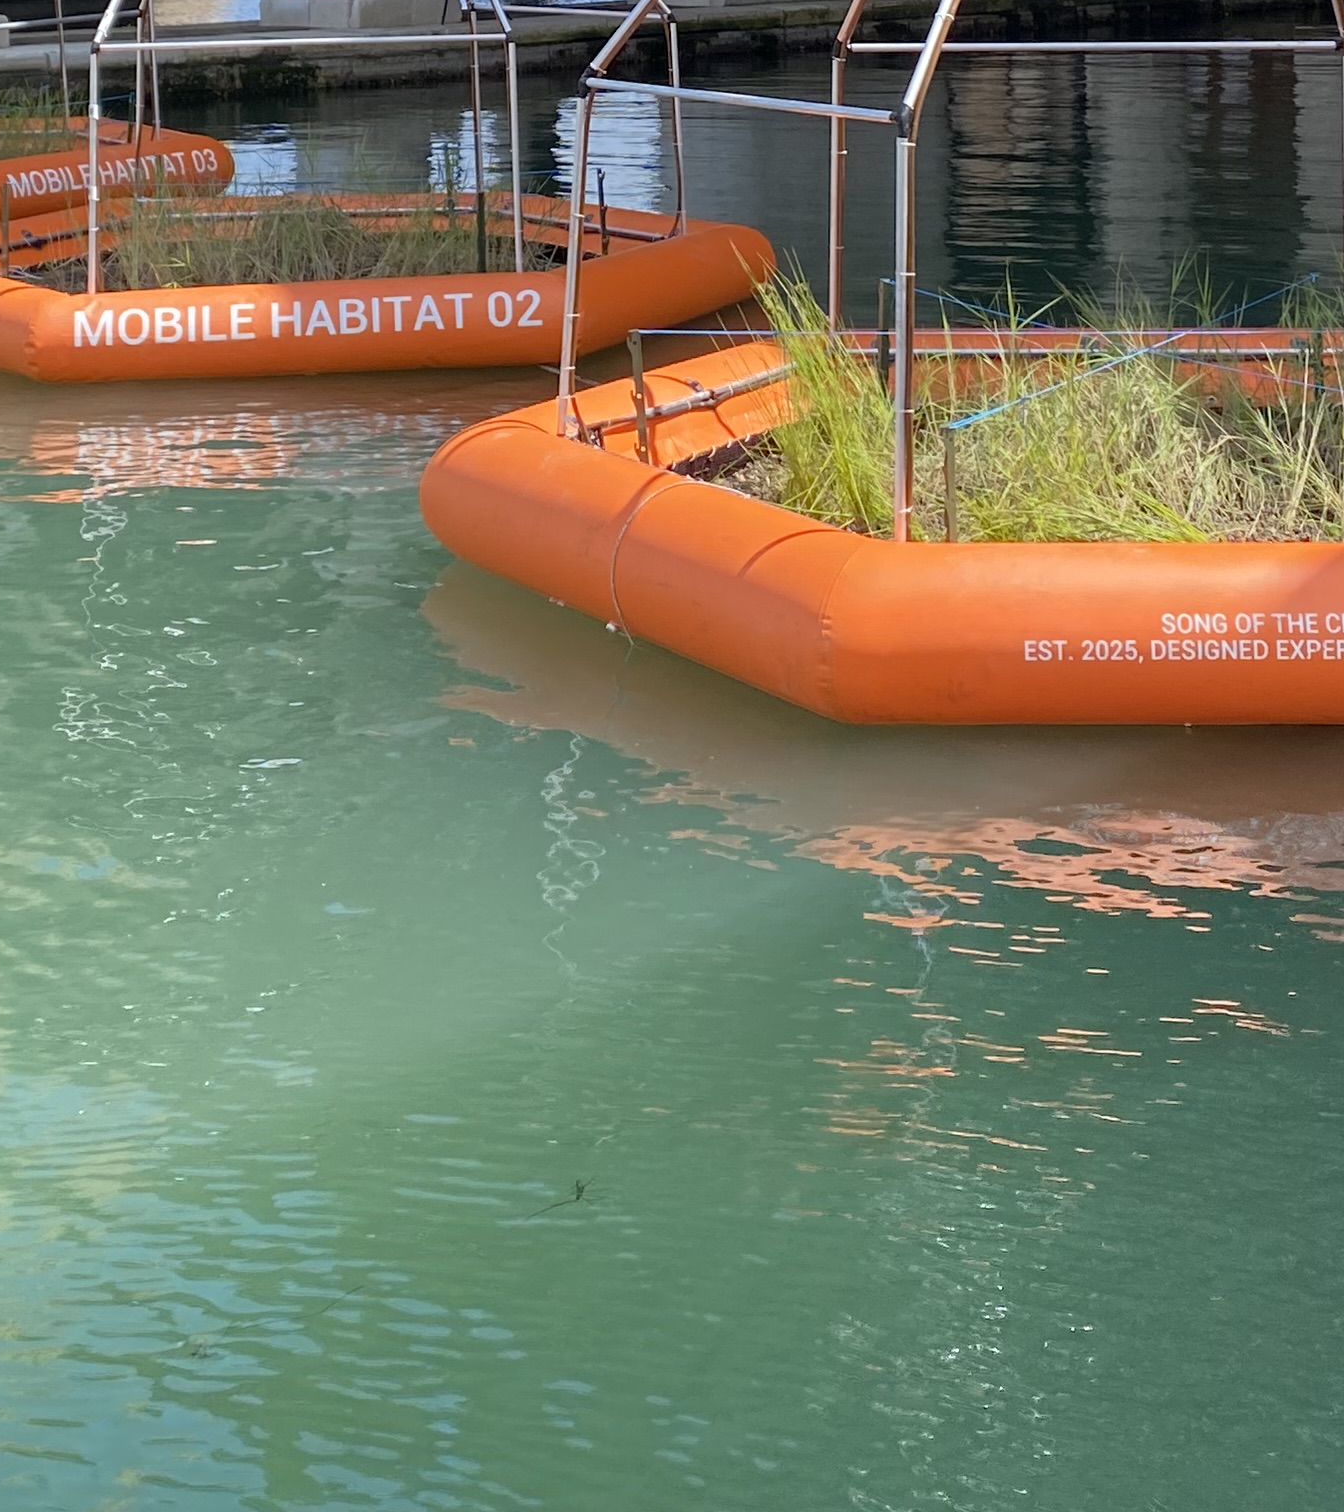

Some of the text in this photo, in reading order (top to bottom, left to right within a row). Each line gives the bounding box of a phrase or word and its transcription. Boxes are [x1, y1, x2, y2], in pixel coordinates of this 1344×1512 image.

[8, 164, 90, 198] MOBILE
[191, 149, 218, 173] 03
[73, 289, 543, 348] MOBILE HABITAT 02
[1161, 613, 1228, 634] SONG
[1234, 613, 1266, 634] OF
[1270, 613, 1319, 634] THE
[1023, 640, 1074, 661] EST.
[1081, 640, 1144, 664] 2025,
[1150, 639, 1269, 660] DESIGNED
